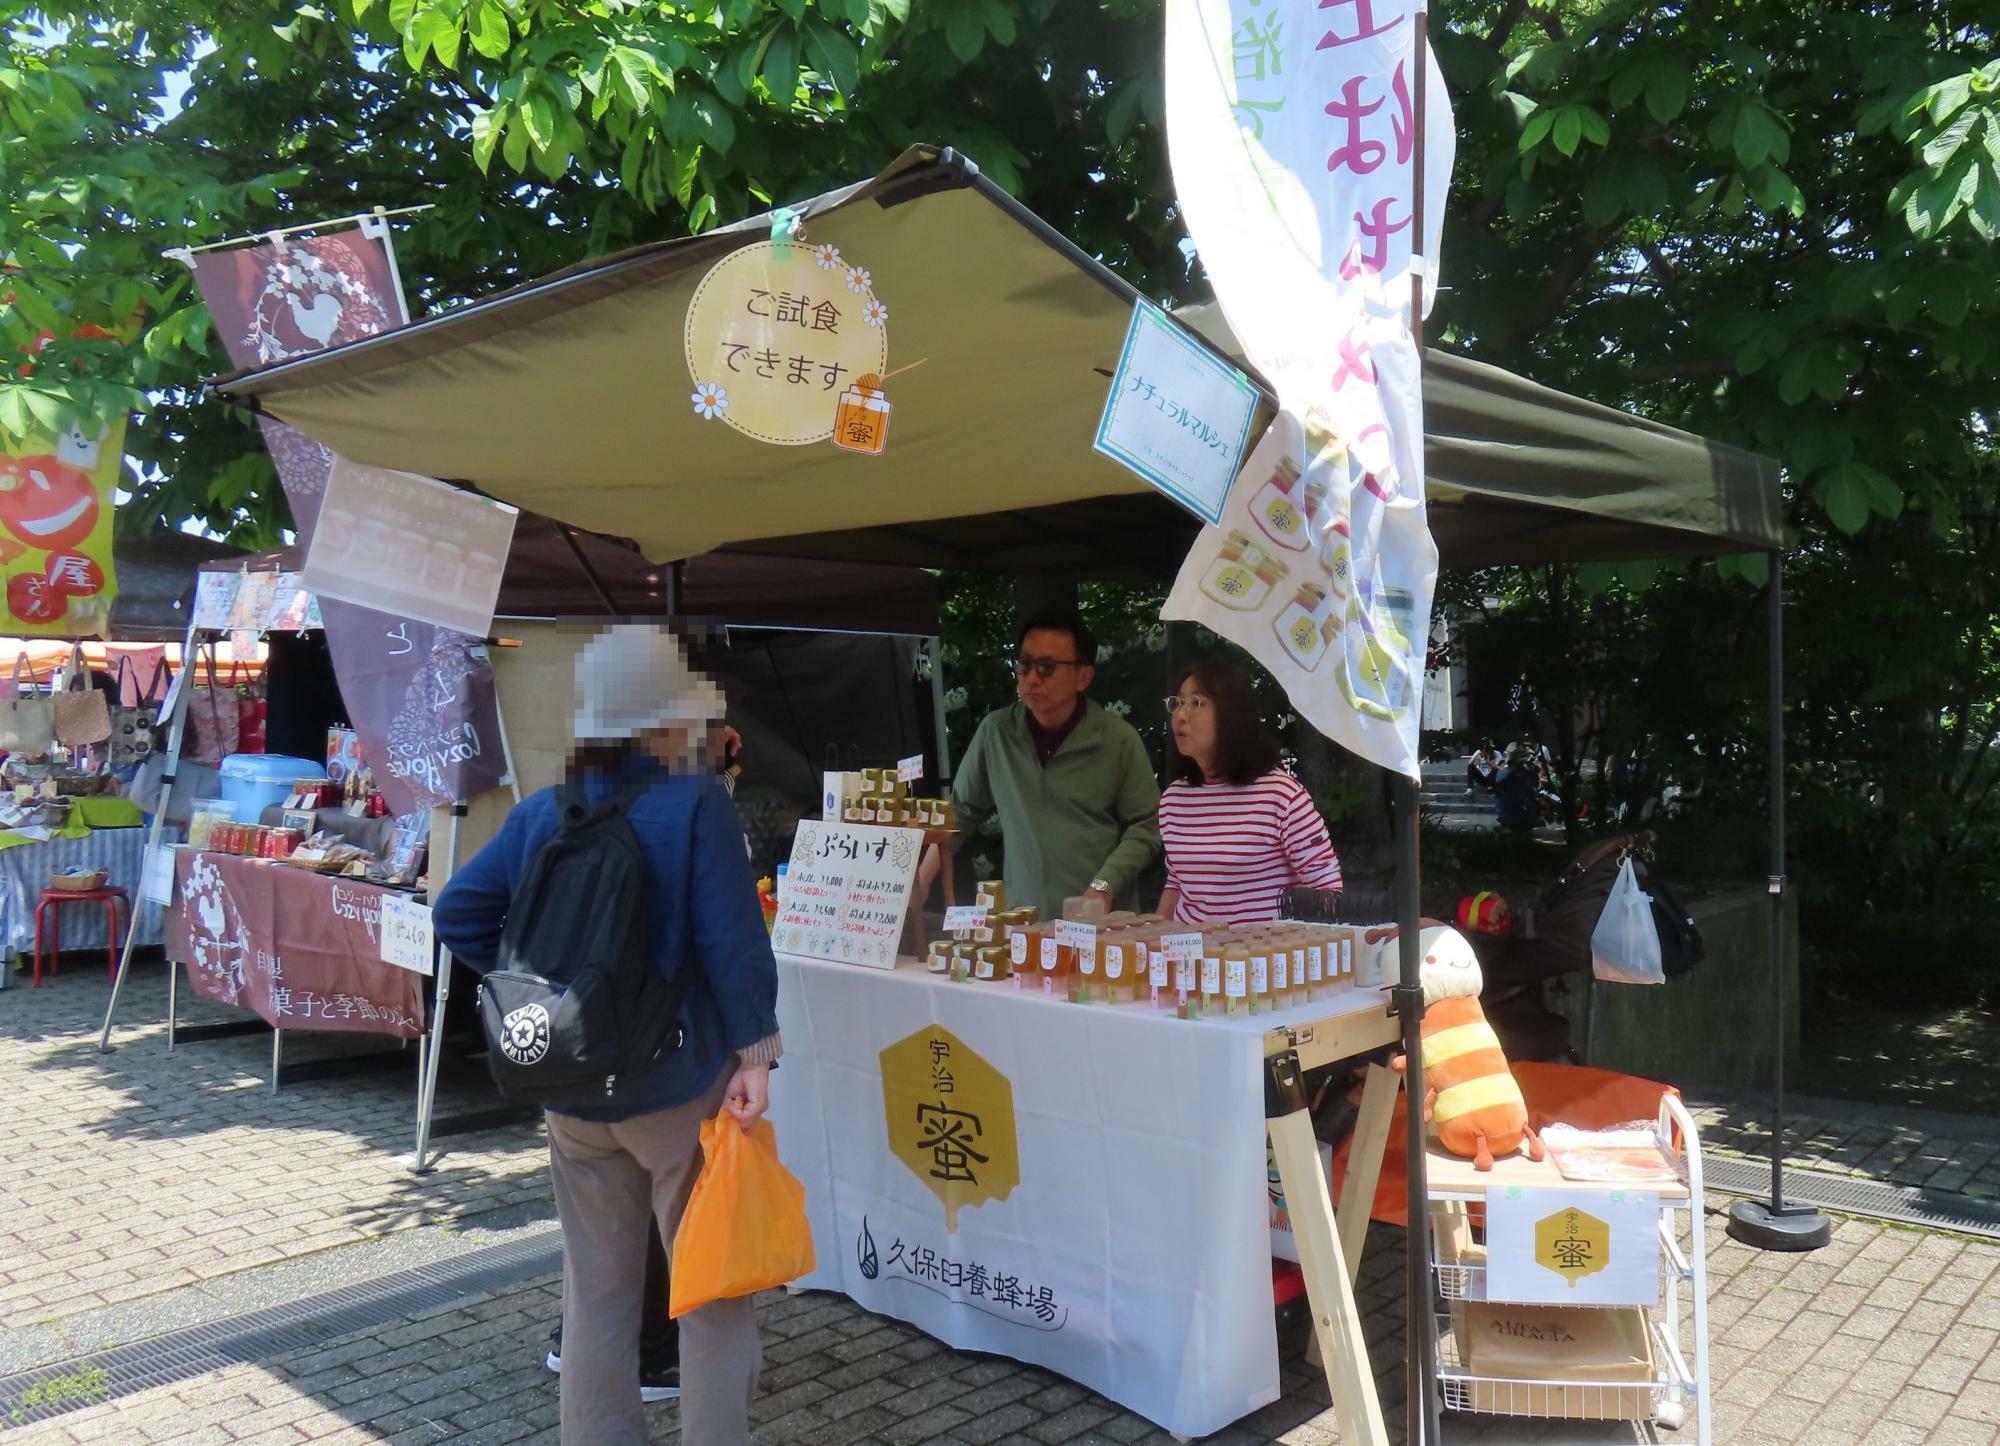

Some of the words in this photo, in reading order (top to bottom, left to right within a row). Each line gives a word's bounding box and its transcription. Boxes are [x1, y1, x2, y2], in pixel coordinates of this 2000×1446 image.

[746, 288, 842, 334] ご試食
[721, 342, 849, 391] できます
[1130, 374, 1232, 459] ナチュラルマルシェ
[816, 832, 891, 863] ぷらいす
[362, 907, 382, 945] HOU
[929, 1039, 954, 1094] 宇治
[916, 1101, 990, 1186] 蜜
[1552, 1235, 1594, 1269] 蜜
